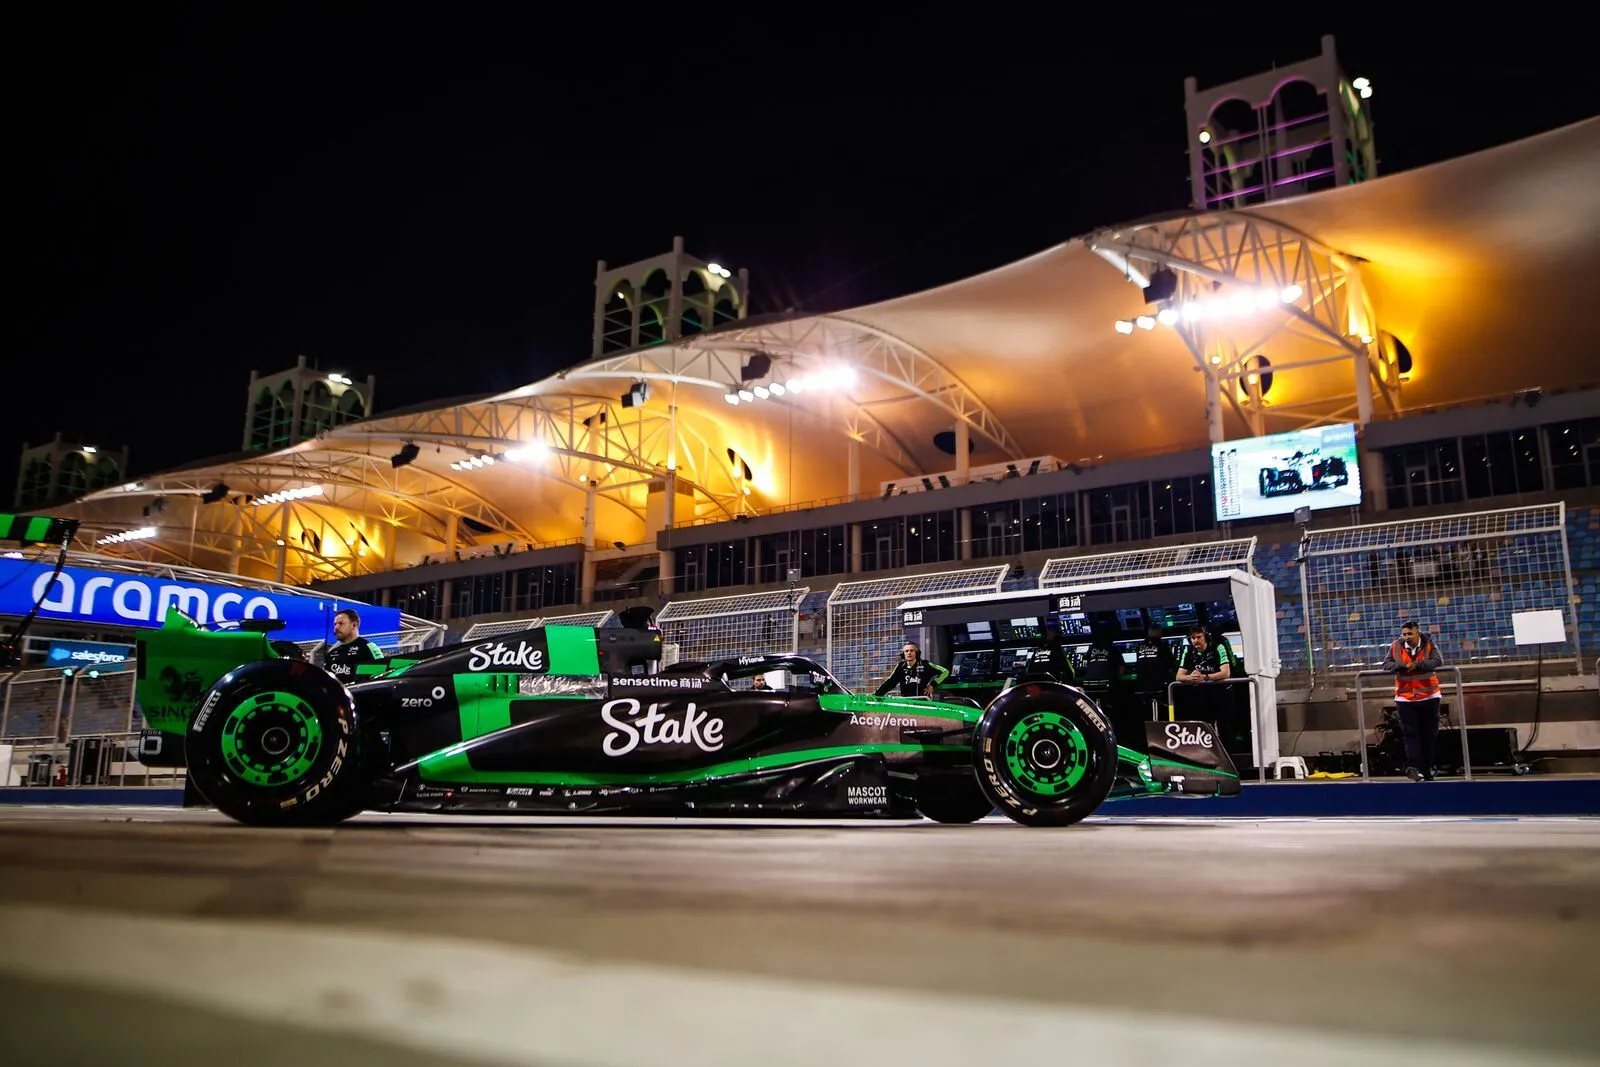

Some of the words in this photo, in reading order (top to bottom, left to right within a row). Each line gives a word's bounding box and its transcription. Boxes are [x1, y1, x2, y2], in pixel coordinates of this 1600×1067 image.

[32, 571, 279, 631] aramco
[71, 649, 125, 664] salesforce
[468, 640, 542, 671] Stake
[330, 663, 351, 675] Stake
[612, 677, 678, 687] sensetime
[337, 717, 349, 735] P
[601, 698, 724, 756] Stake
[1165, 723, 1213, 749] Stake
[306, 738, 348, 801] ZERO
[848, 786, 887, 797] MASCOT
[983, 758, 1021, 808] ZERO
[848, 796, 887, 805] WORKWEAR
